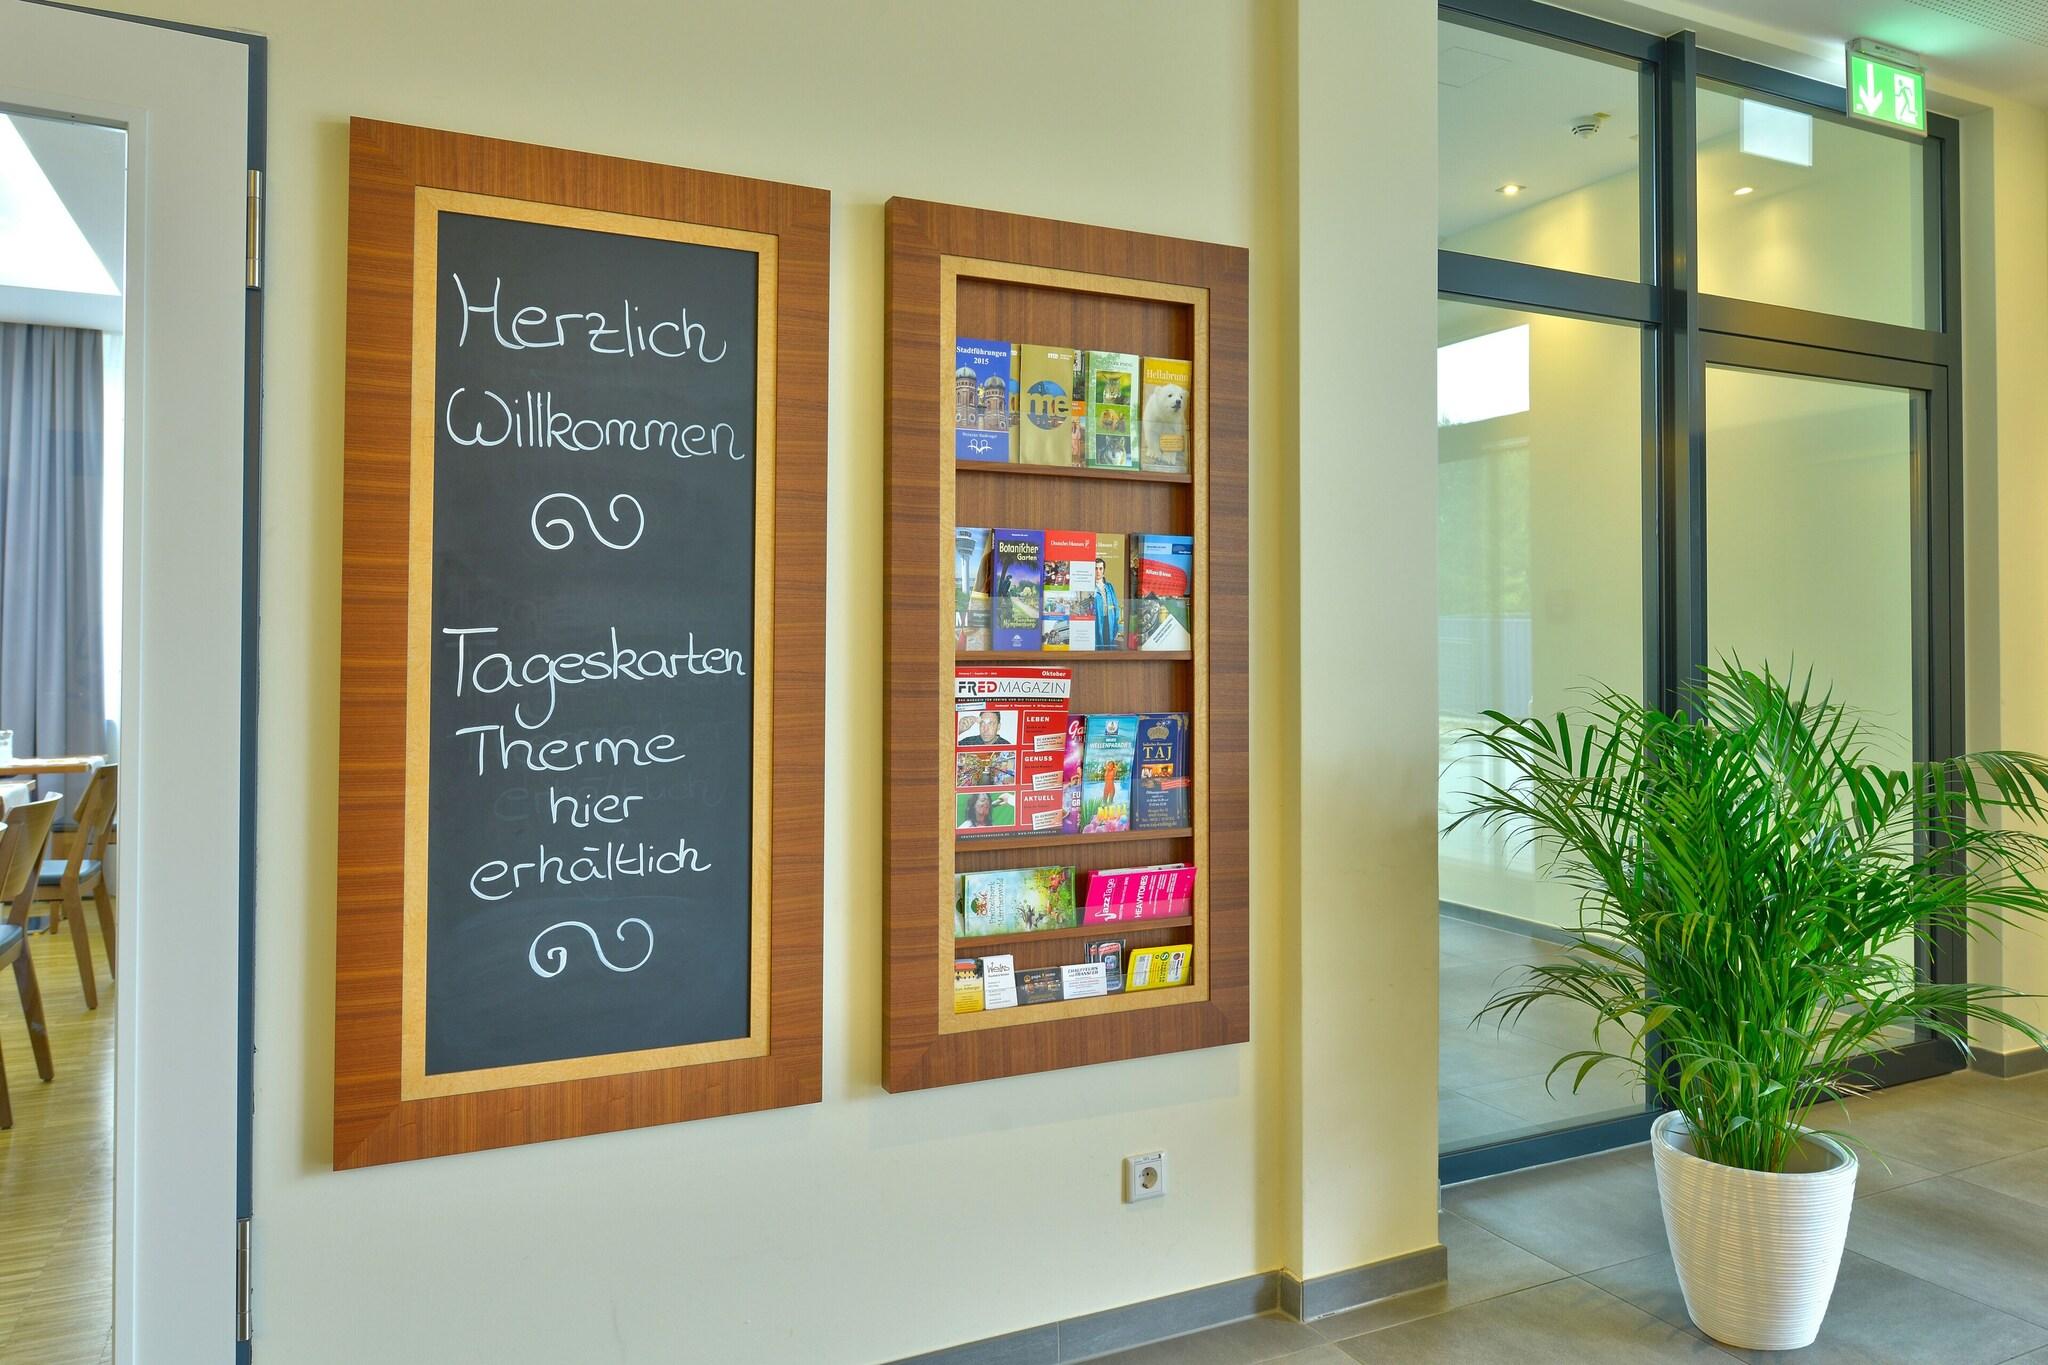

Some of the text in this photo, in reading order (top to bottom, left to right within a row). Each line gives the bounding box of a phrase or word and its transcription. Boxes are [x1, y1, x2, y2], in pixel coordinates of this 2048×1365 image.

[453, 273, 727, 363] Herzlich
[956, 346, 1007, 357] Stadtführungen
[973, 357, 989, 365] 2015
[1146, 369, 1186, 381] Hellabrunn
[447, 388, 745, 460] Willkommen
[1016, 552, 1038, 561] Garten
[443, 627, 746, 729] Tageskarten
[456, 725, 685, 776] Therme
[1143, 746, 1172, 761] TAJ
[551, 786, 643, 828] hier
[1134, 875, 1149, 918] HEAVYTONES
